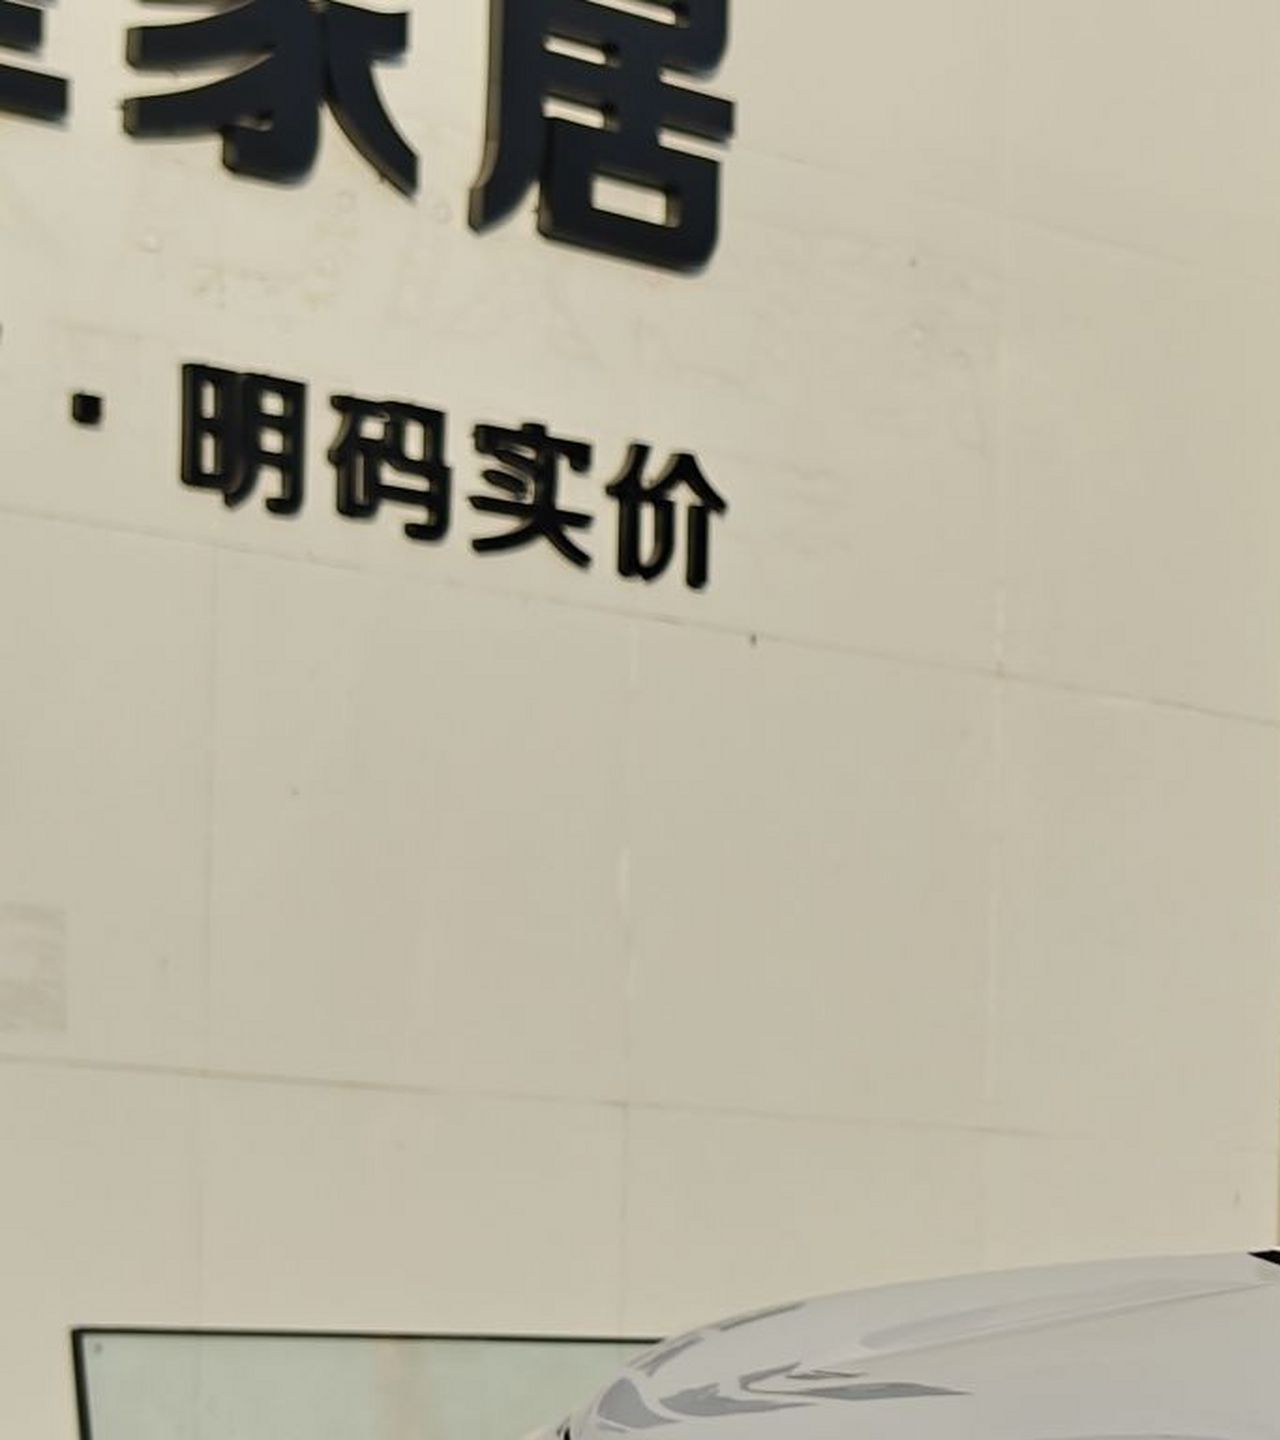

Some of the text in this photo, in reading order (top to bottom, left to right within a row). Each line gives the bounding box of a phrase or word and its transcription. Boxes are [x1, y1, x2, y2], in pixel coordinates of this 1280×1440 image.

[0, 0, 736, 275] 家居
[180, 362, 728, 591] 明码实价
